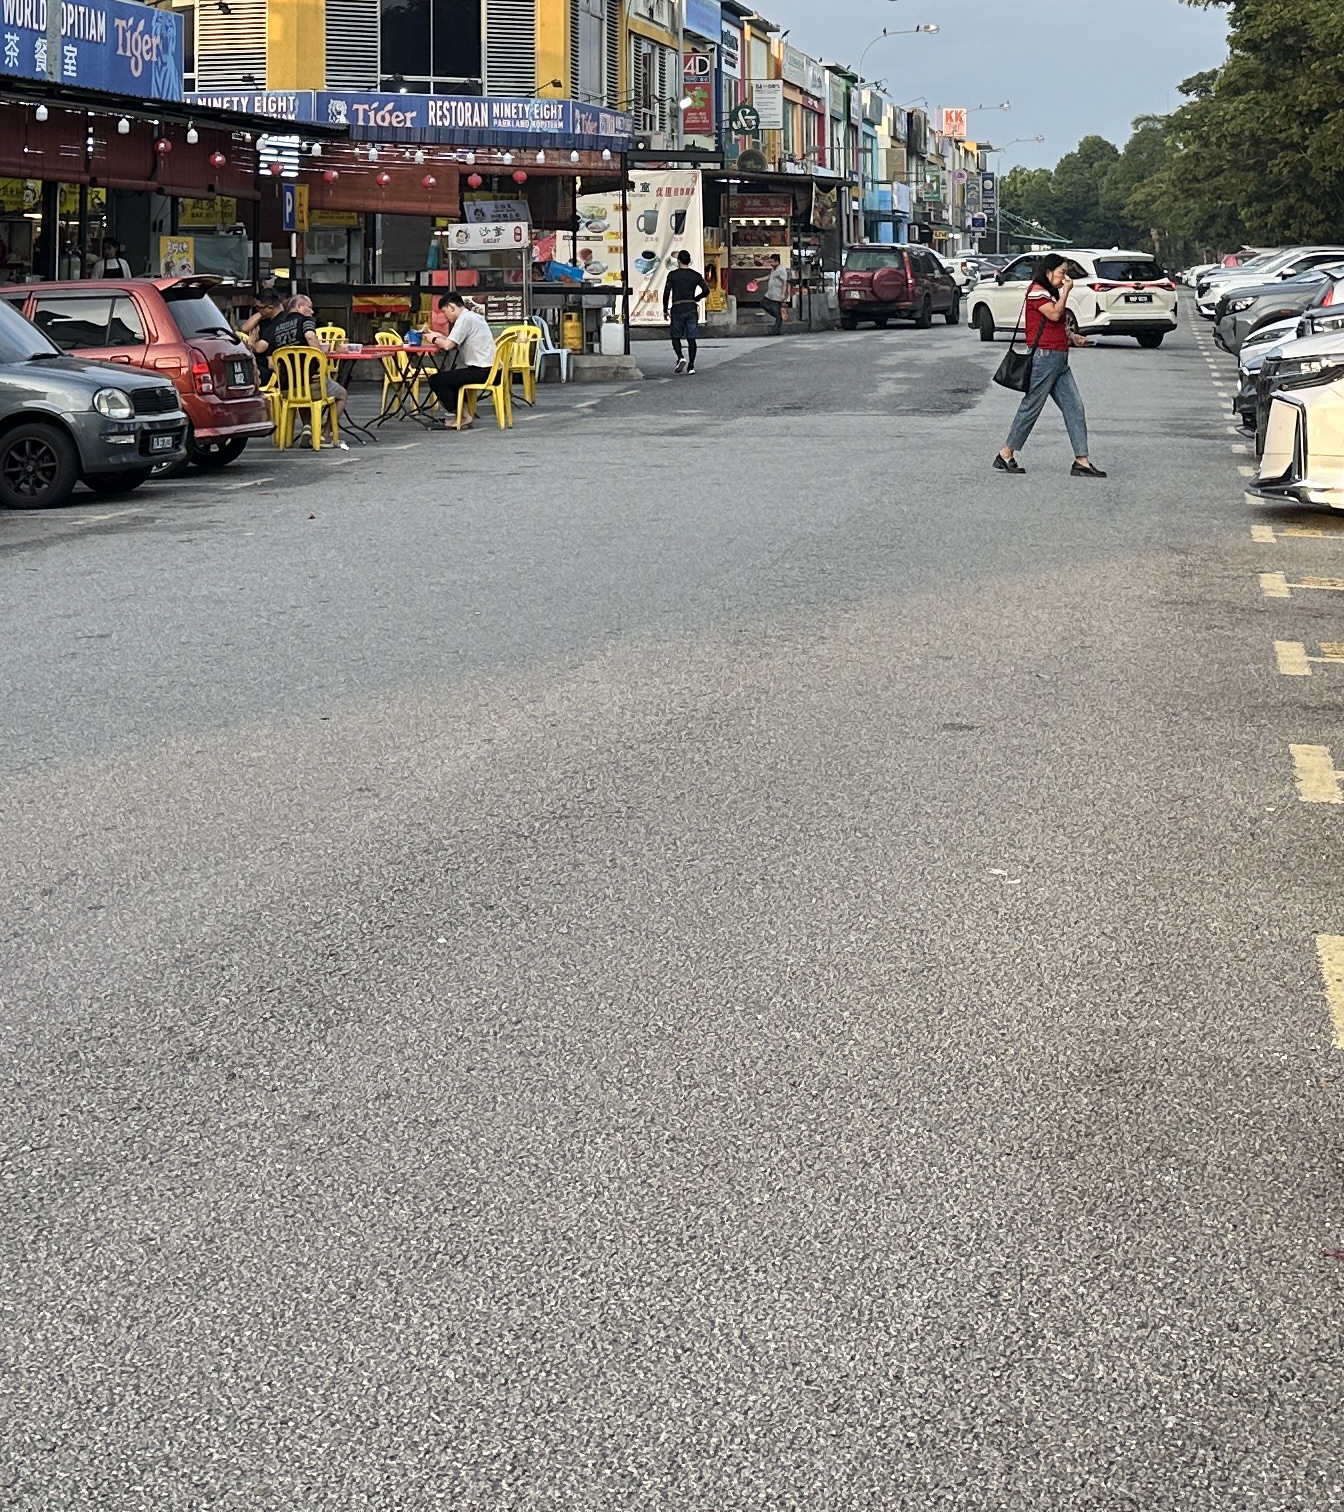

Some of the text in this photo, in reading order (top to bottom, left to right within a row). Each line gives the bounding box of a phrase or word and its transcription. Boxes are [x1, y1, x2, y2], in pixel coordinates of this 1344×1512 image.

[61, 0, 106, 44] OPITIAM
[114, 17, 160, 78] Tiger
[684, 54, 710, 77] 4D
[254, 96, 296, 113] EIGHT
[352, 101, 417, 128] Tiger
[428, 101, 489, 128] RESTORAN
[492, 102, 564, 120] NINETY EIGHT
[944, 109, 964, 124] KK
[285, 191, 293, 223] P
